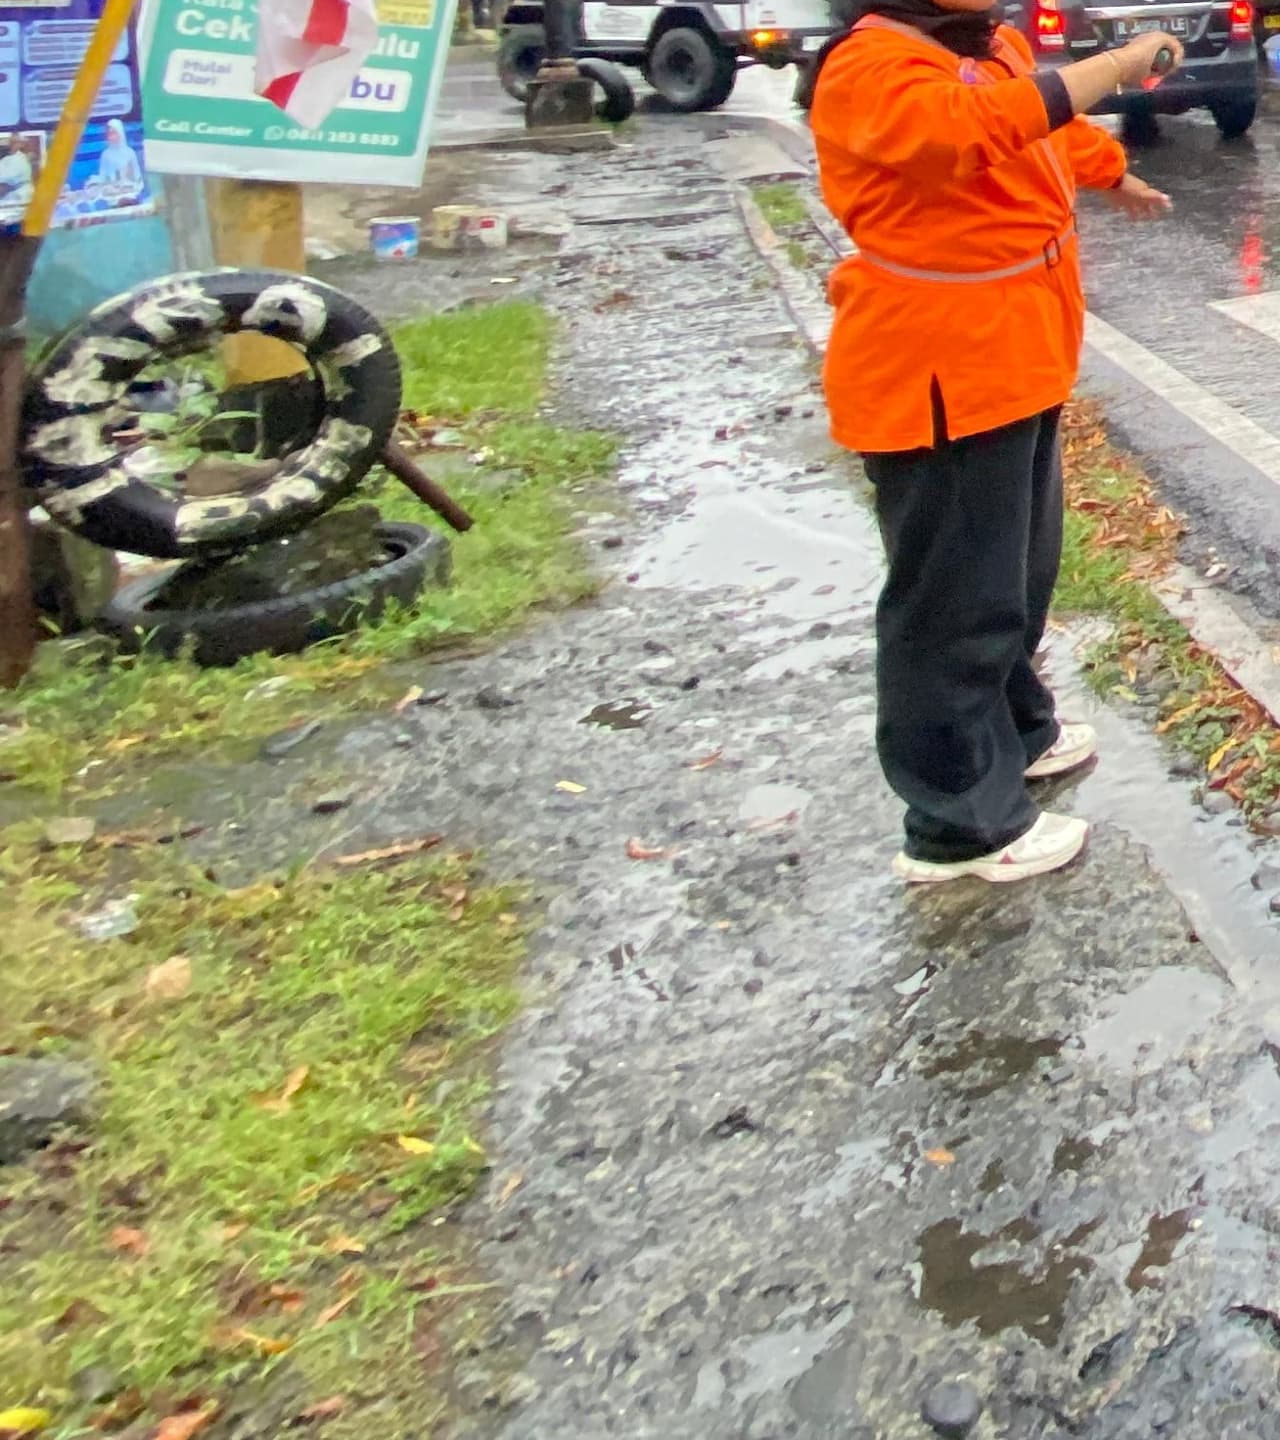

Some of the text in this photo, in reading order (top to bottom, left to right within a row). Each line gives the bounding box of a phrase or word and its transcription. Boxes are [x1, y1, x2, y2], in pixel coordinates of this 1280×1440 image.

[175, 9, 254, 42] Cek
[370, 32, 420, 59] ulu
[182, 59, 232, 75] Mulai
[350, 75, 397, 102] bu
[154, 118, 254, 139] Call Center
